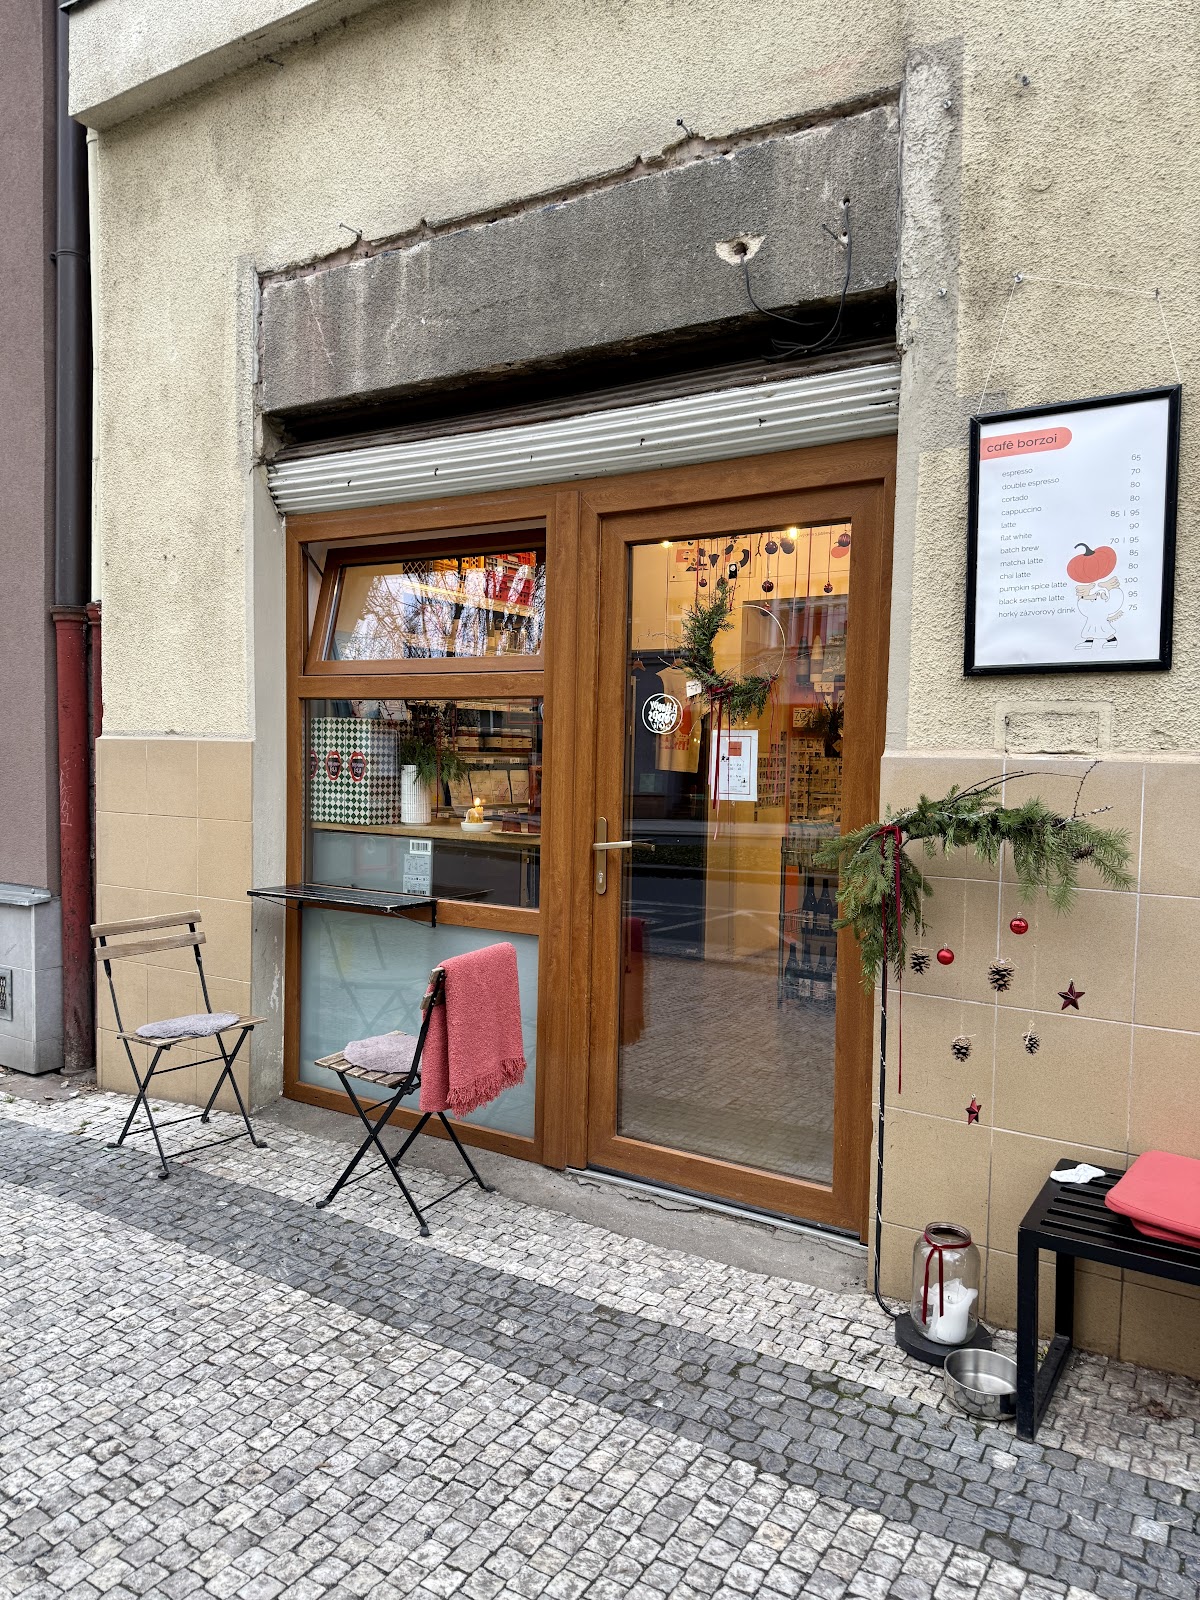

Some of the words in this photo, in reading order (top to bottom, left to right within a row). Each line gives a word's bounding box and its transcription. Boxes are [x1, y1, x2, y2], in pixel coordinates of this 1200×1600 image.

[987, 441, 1014, 453] café
[1018, 434, 1057, 448] borzoi
[1002, 468, 1033, 478] espresso
[1002, 481, 1026, 490] double
[1028, 477, 1059, 488] espresso
[1002, 495, 1028, 503] cortado
[1001, 506, 1042, 516] cappuccino
[1000, 558, 1026, 567] matcha
[1000, 584, 1030, 593] pumpkin
[1031, 583, 1049, 591] spice
[999, 610, 1018, 618] horký
[1019, 608, 1055, 617] zázvorový
